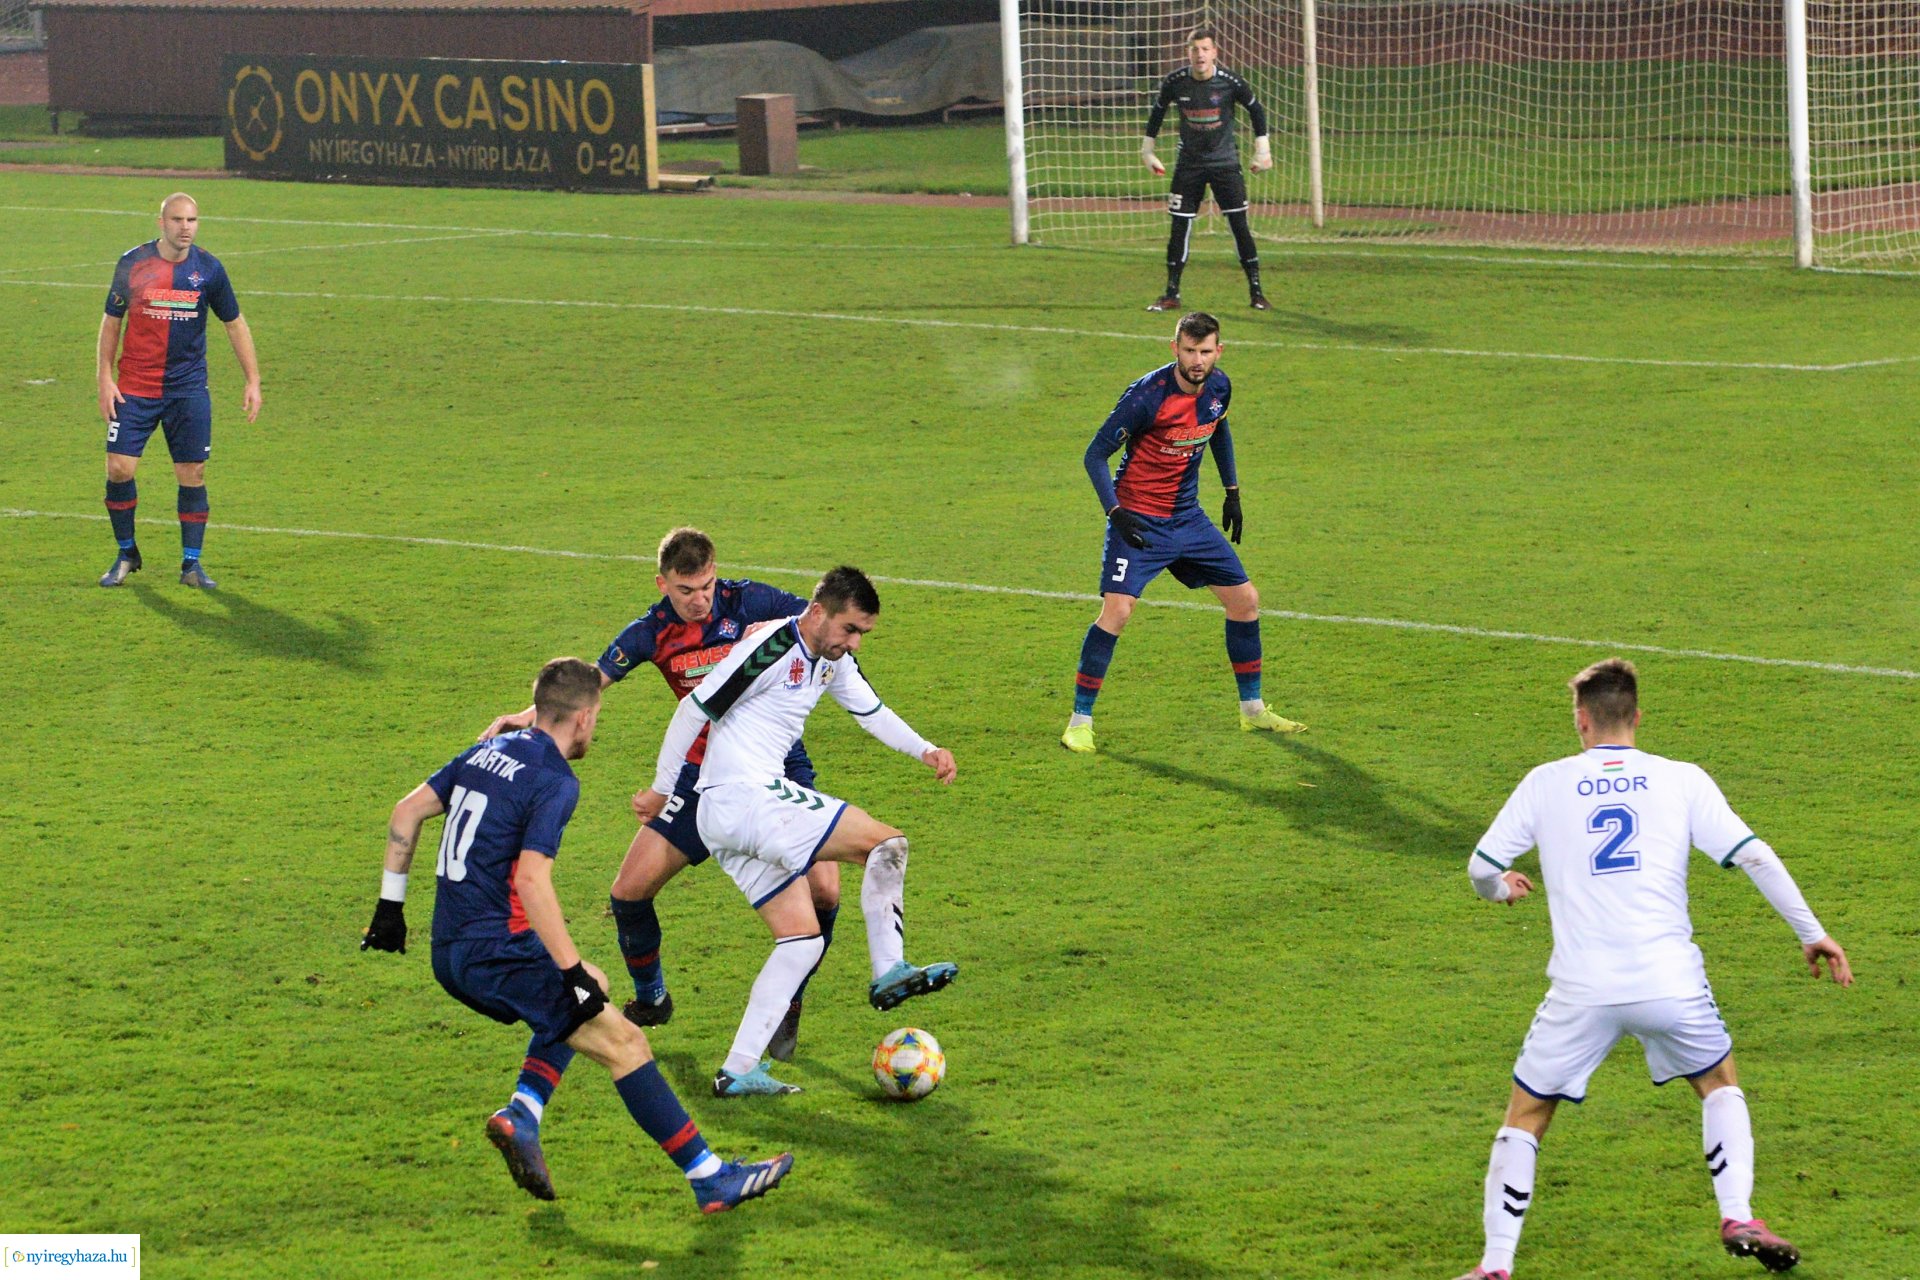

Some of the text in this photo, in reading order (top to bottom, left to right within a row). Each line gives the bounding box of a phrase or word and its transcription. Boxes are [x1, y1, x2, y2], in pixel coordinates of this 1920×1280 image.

[295, 69, 614, 135] ONYX CASINO
[577, 142, 640, 176] 0-24
[1112, 557, 1129, 582] 3
[1577, 775, 1648, 796] ÓDOR
[435, 784, 488, 882] 10
[1586, 803, 1641, 875] 2
